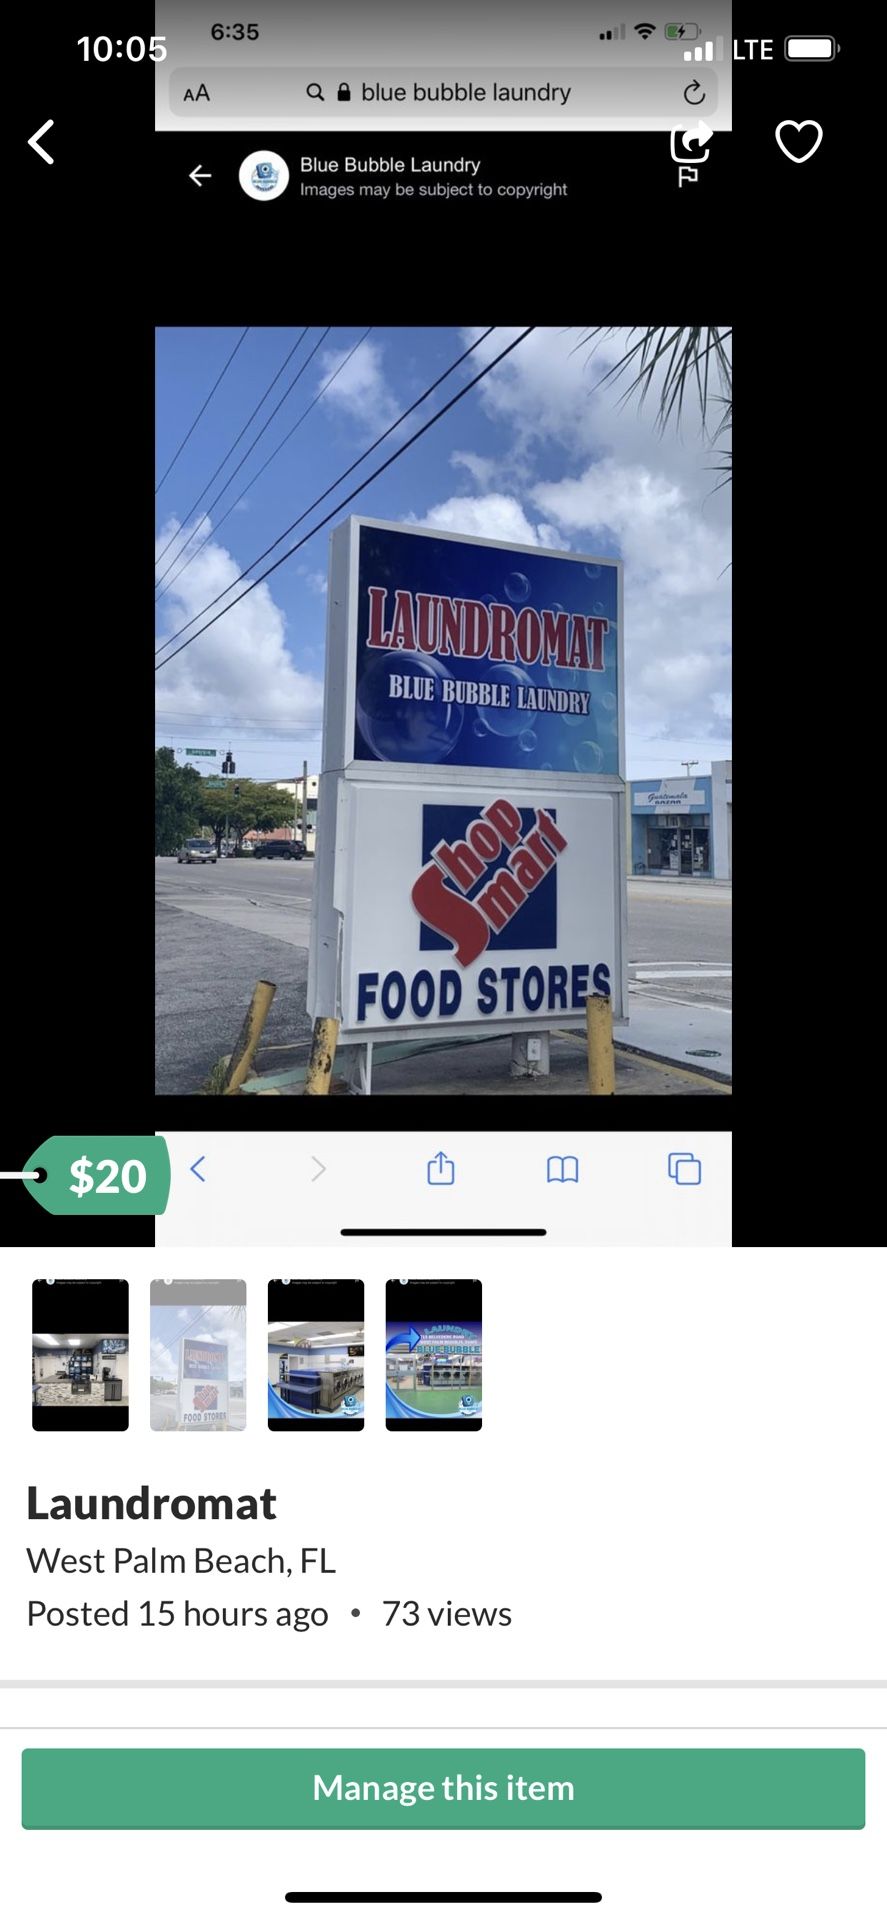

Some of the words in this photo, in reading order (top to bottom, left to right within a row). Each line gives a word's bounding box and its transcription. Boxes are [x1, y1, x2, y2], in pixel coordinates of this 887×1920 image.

[210, 22, 260, 41] 6:35
[77, 35, 168, 62] 10:05
[733, 39, 774, 60] LTE
[362, 82, 407, 102] blue
[413, 82, 487, 102] bubble
[493, 82, 572, 107] laundry
[300, 156, 339, 173] Blue
[344, 156, 405, 173] Bubble
[411, 156, 481, 177] Laundry
[300, 182, 355, 200] Images
[359, 185, 391, 200] may
[395, 182, 415, 197] be
[418, 182, 474, 200] subject
[477, 183, 493, 197] to
[497, 182, 568, 200] copyright
[366, 586, 609, 672] LAUNDROMAT
[389, 674, 434, 701] BLUE
[442, 679, 510, 708] BUBBLE
[516, 686, 590, 714] LAUNDRY
[411, 797, 522, 968] Shop
[357, 969, 462, 1021] FOOD
[477, 963, 611, 1014] STORES
[69, 1155, 147, 1199] $20
[443, 1345, 481, 1354] BUBBLE
[184, 1412, 202, 1423] FOOD
[204, 1411, 227, 1421] STORES
[27, 1485, 277, 1521] Laundromat
[26, 1546, 105, 1575] West
[115, 1546, 187, 1575] Palm
[195, 1546, 293, 1579] Beach,
[301, 1547, 337, 1575] FL
[27, 1599, 129, 1628] Posted
[139, 1600, 176, 1628] 15
[184, 1599, 268, 1628] hours
[276, 1607, 329, 1634] ago
[382, 1600, 420, 1628] 73
[427, 1600, 512, 1628] views
[313, 1774, 435, 1807] Manage
[442, 1773, 498, 1802] this
[507, 1774, 575, 1802] item
